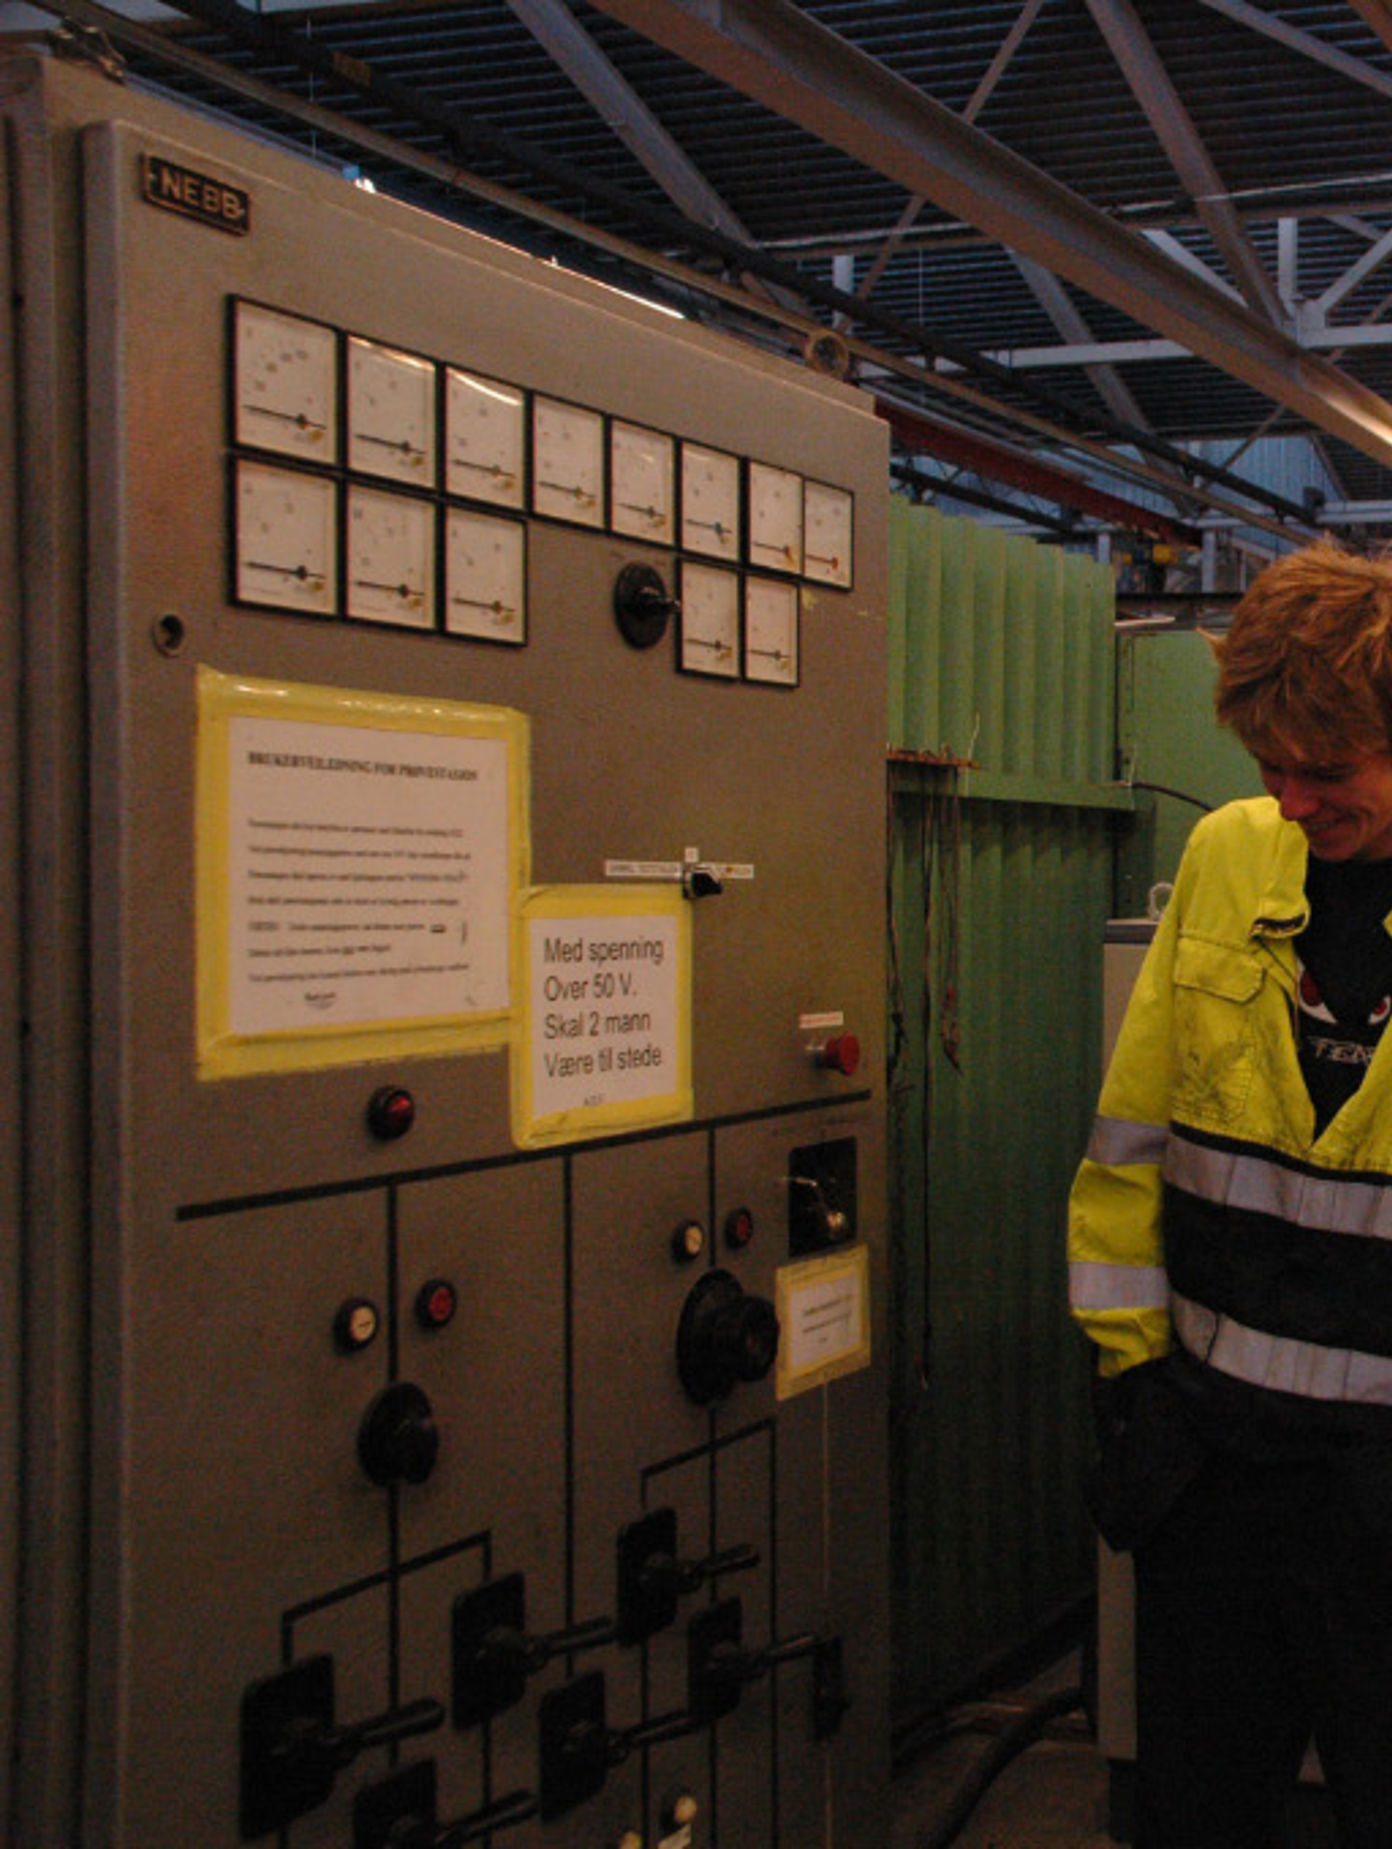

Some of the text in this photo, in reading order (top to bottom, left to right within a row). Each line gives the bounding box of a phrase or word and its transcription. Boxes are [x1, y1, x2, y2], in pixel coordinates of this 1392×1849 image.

[160, 165, 240, 219] NEBB
[544, 937, 664, 966] Med spenning
[544, 972, 638, 1002] Over 50 V.
[544, 1010, 651, 1040] Skal 2 mann
[544, 1043, 662, 1079] Være til stede
